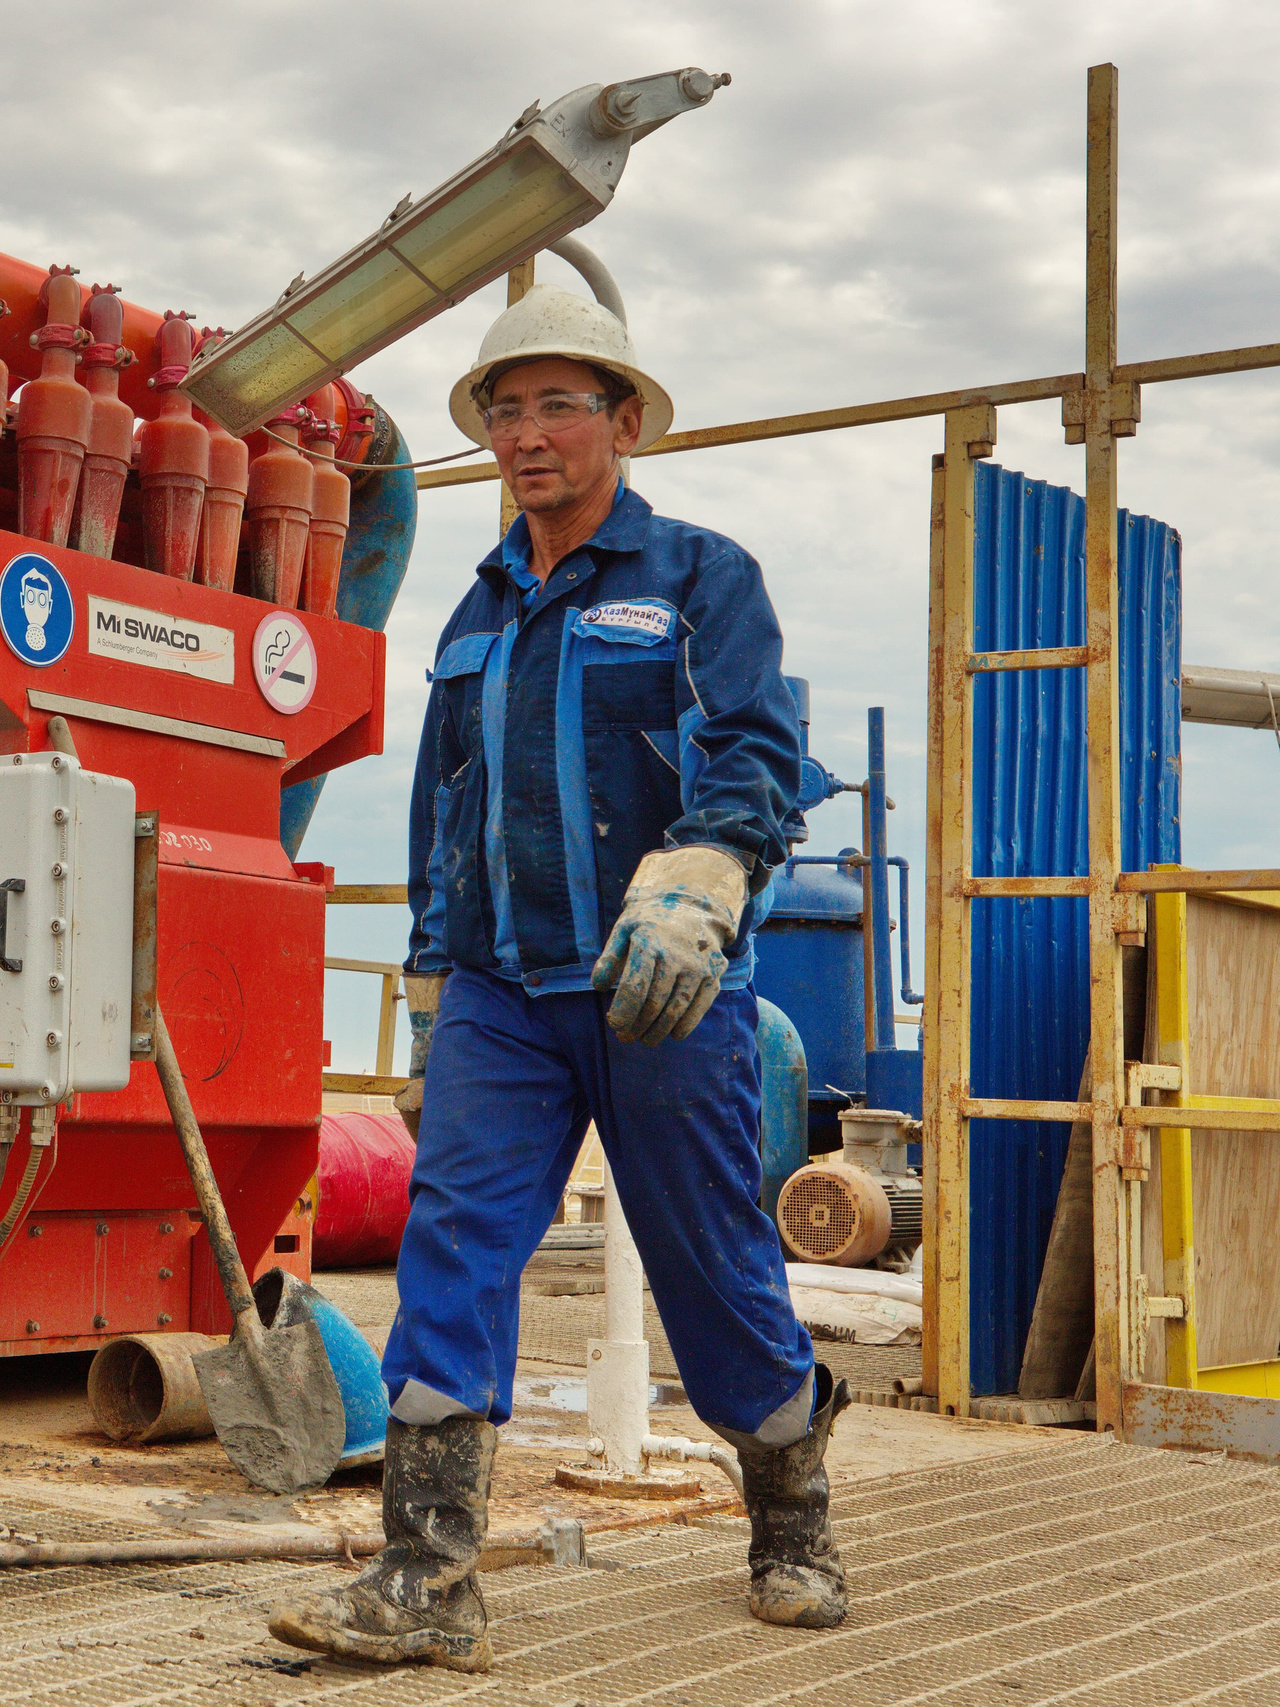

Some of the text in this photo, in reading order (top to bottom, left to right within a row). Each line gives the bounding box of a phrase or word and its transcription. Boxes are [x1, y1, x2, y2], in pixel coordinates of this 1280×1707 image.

[102, 638, 135, 653] Schlumberger
[135, 646, 158, 659] Company
[124, 618, 200, 652] SWACO
